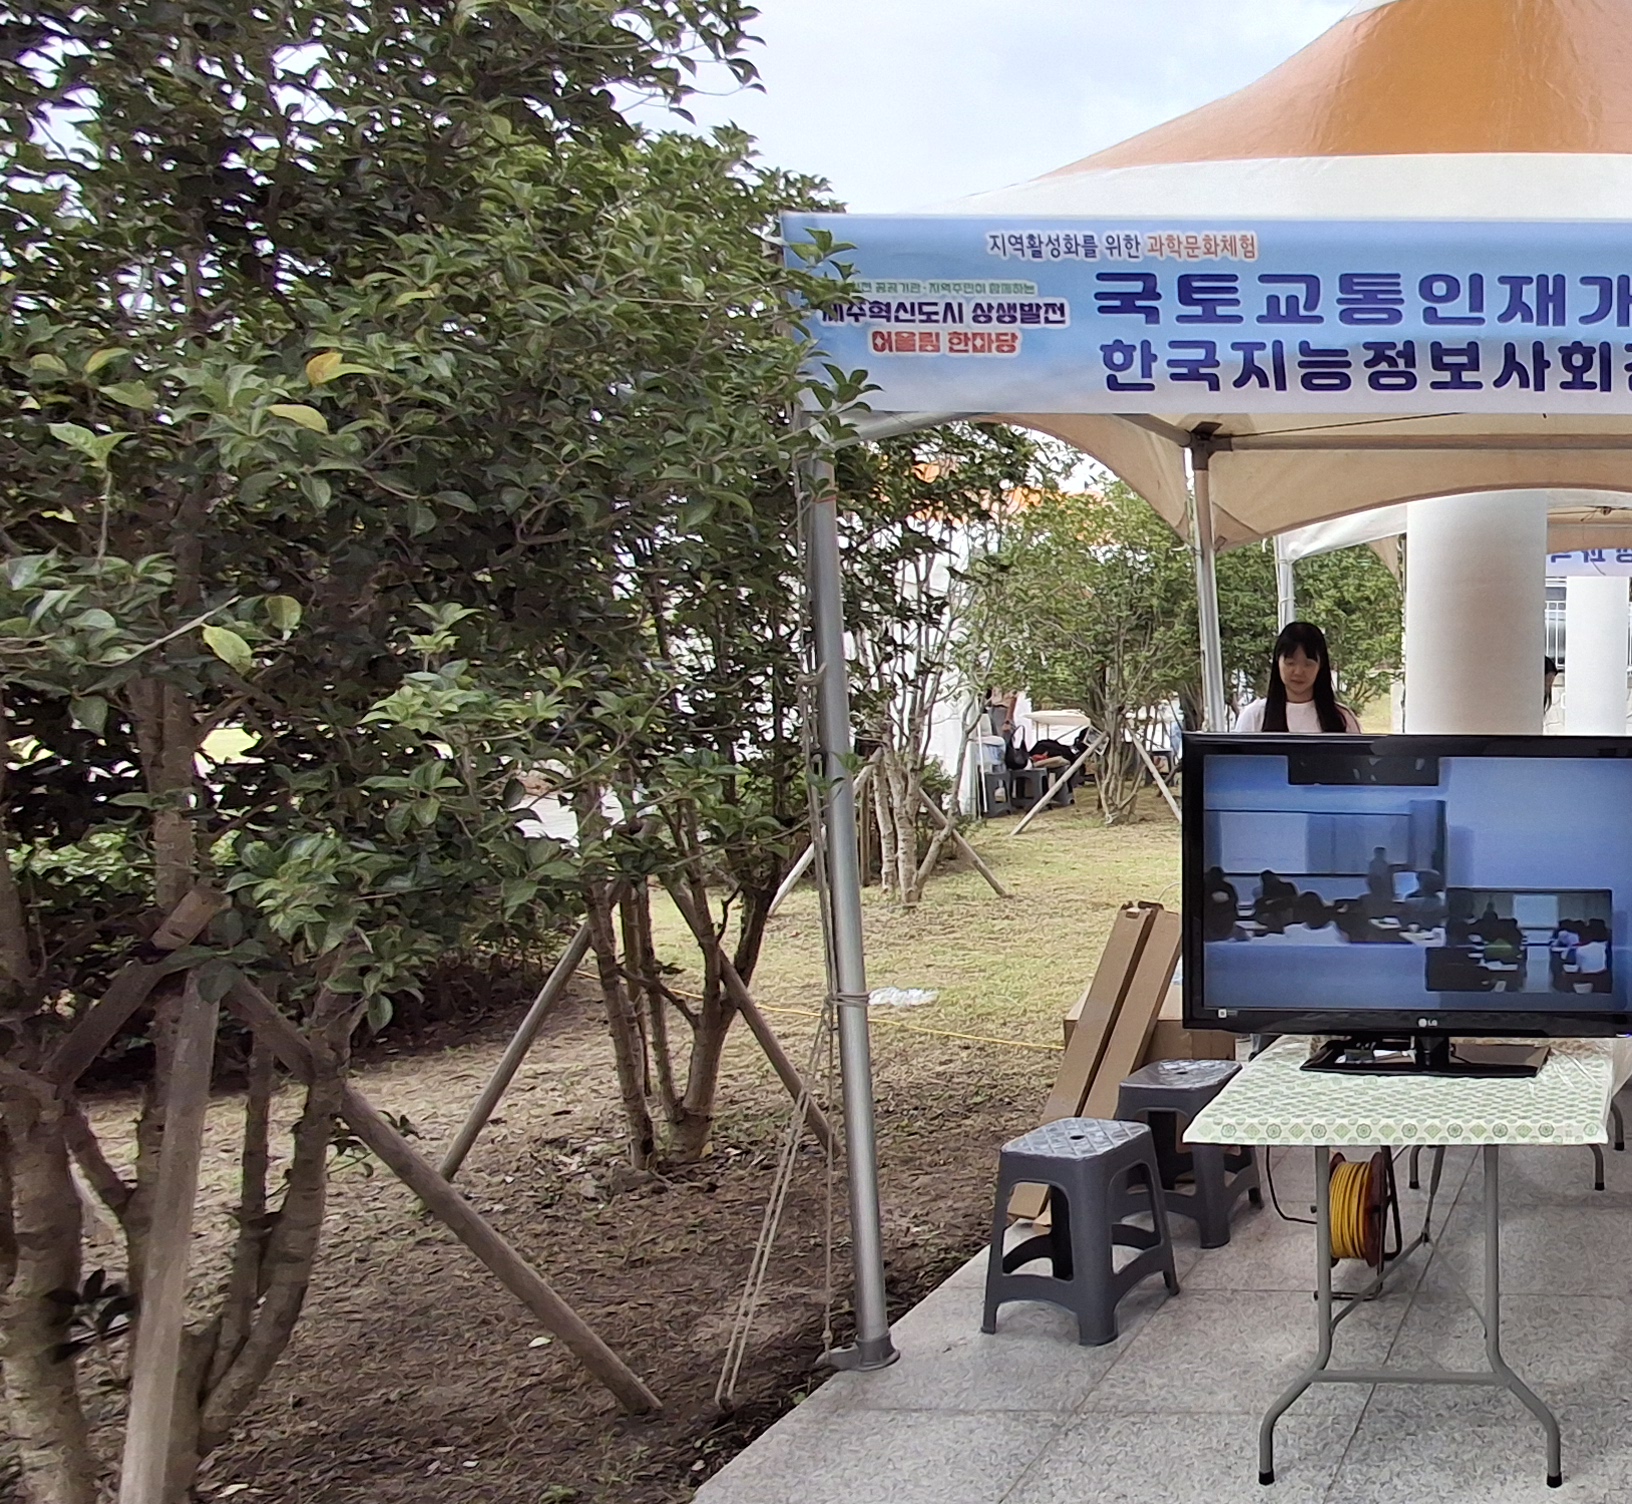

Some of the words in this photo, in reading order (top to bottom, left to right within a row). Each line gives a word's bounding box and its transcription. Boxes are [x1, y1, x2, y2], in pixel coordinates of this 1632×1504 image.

[988, 233, 1098, 259] 지역활성화를
[1105, 234, 1141, 258] 위한
[1147, 234, 1256, 259] 과학문화체험
[971, 302, 1067, 325] 상생발전
[871, 331, 941, 354] 어울림
[947, 331, 1019, 354] 한마당
